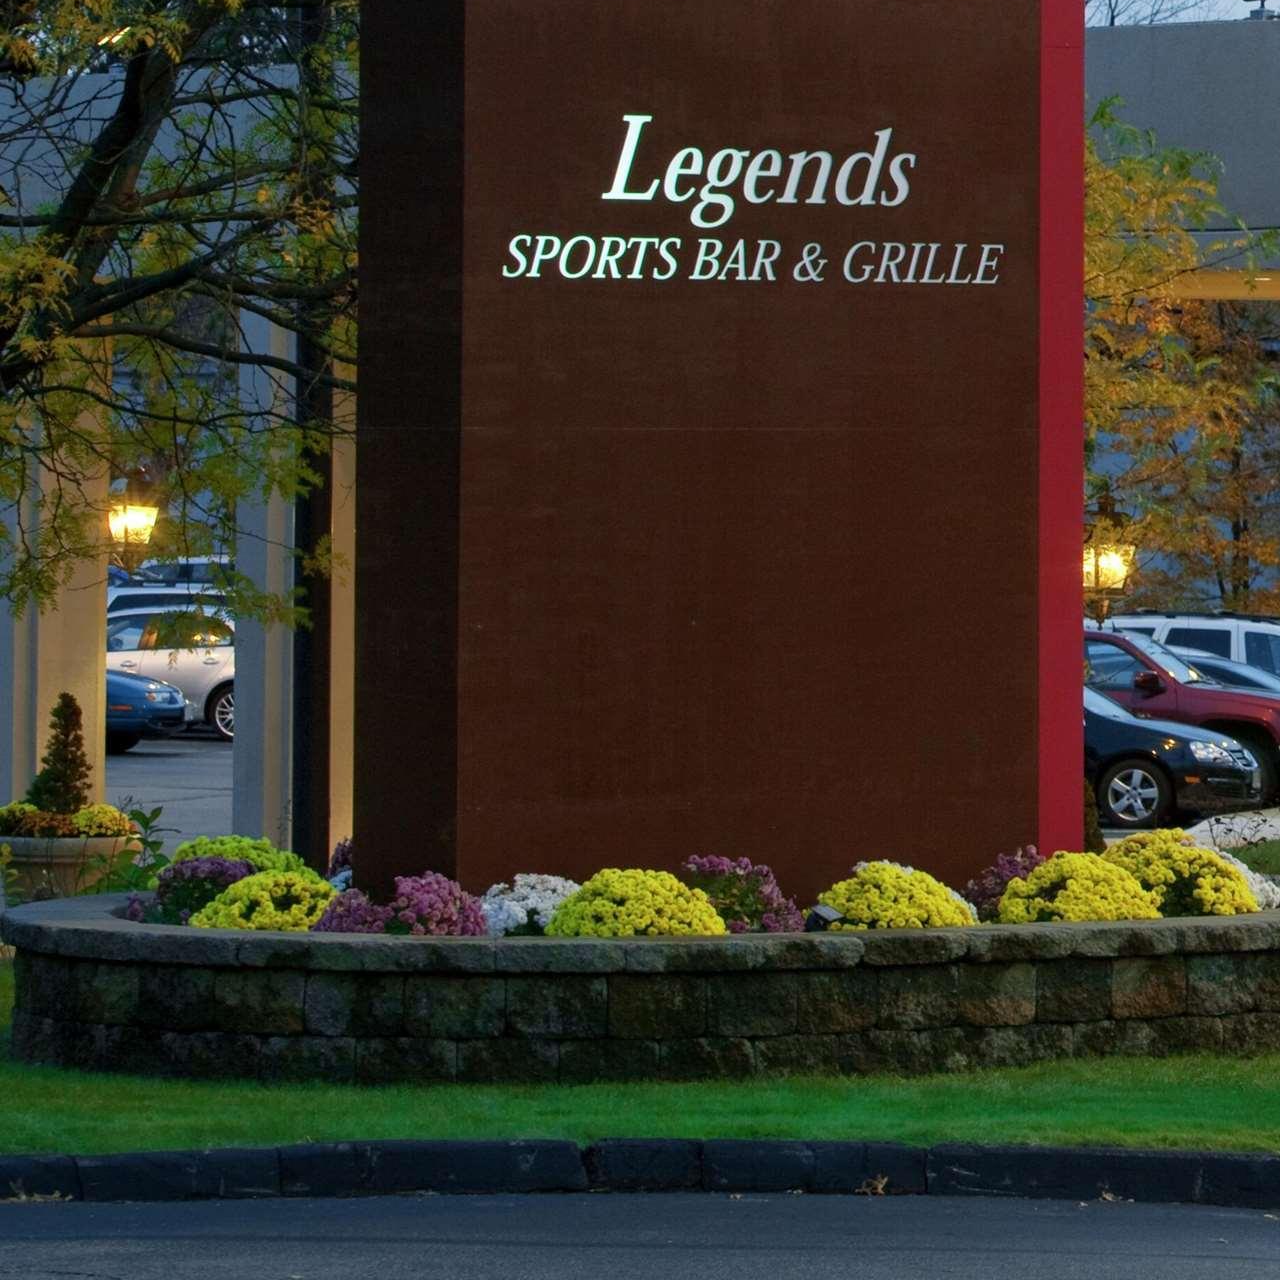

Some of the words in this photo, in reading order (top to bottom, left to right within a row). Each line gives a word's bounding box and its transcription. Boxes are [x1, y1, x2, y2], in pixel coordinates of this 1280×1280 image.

[601, 114, 916, 229] Legends
[502, 234, 681, 280] SPORTS
[689, 238, 782, 281] BAR
[792, 242, 828, 282] &
[842, 242, 1004, 284] GRILLE
